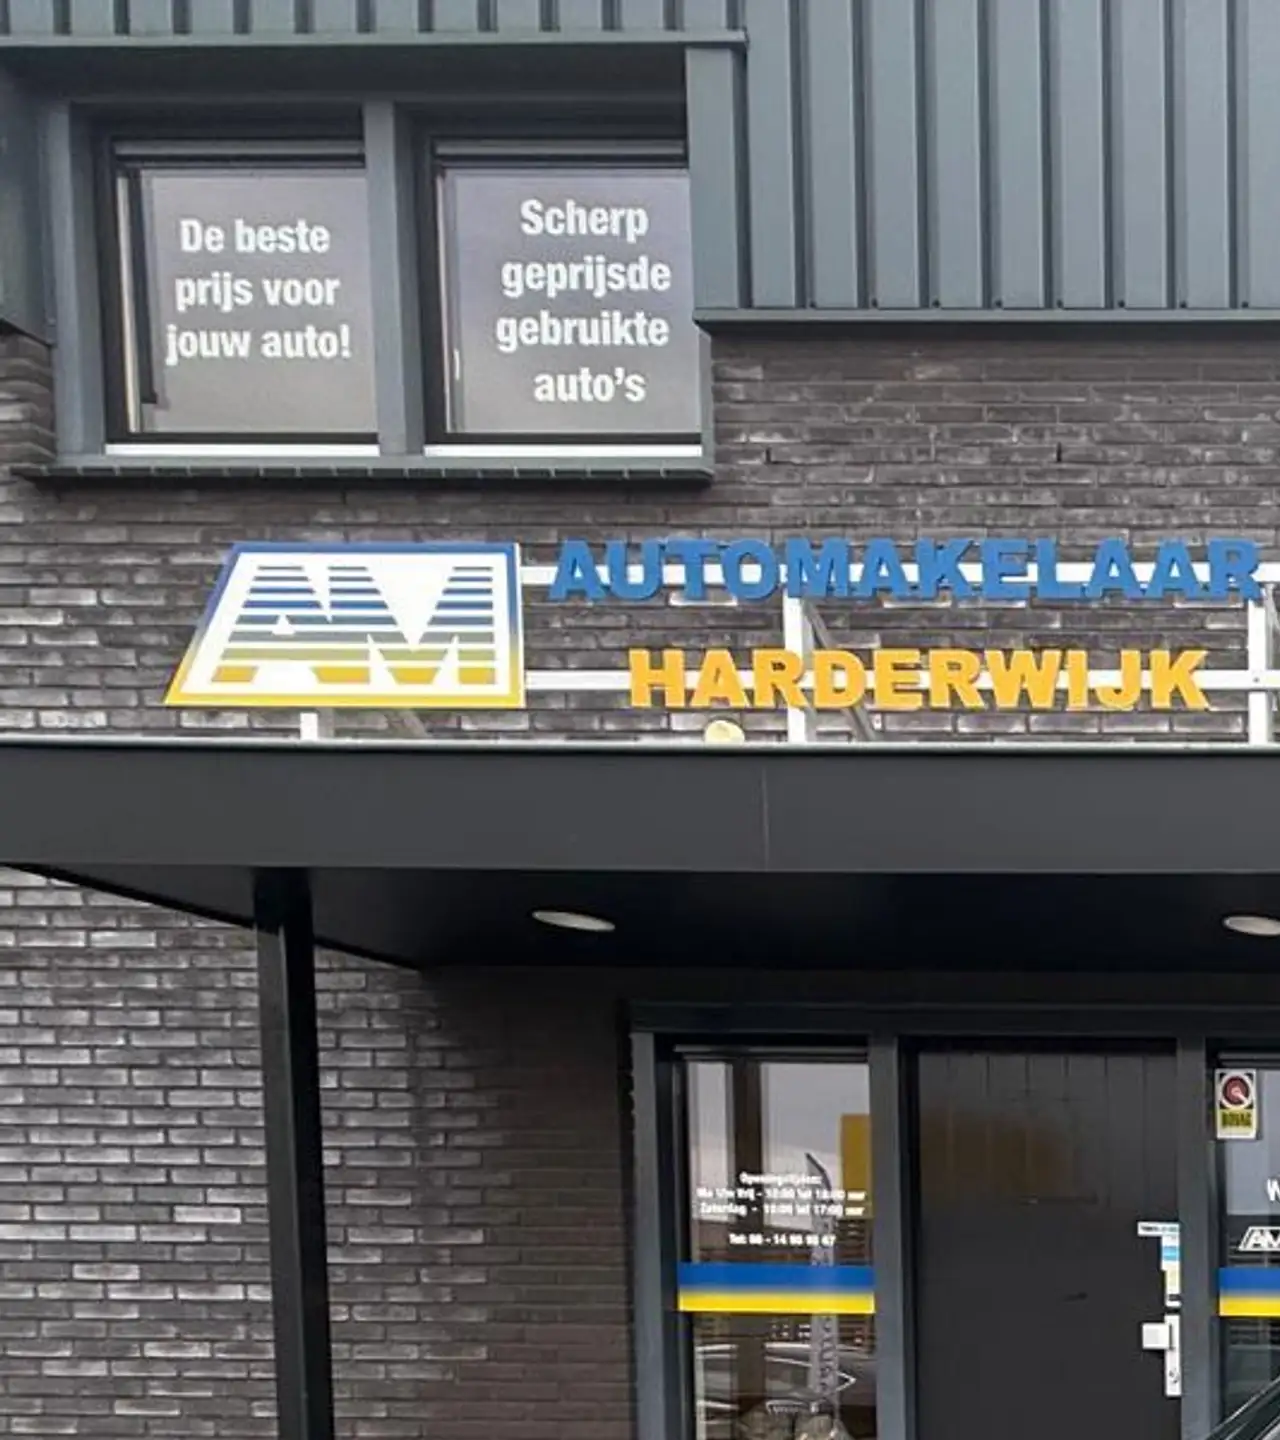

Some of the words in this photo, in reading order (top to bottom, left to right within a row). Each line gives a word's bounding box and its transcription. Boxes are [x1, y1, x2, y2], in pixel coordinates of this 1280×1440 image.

[180, 218, 225, 253] De
[235, 218, 331, 253] beste
[520, 198, 650, 244] Scherp
[175, 270, 253, 313] prijs
[262, 278, 341, 307] voor
[501, 255, 672, 299] geprijsde
[165, 323, 251, 367] jouw
[261, 323, 352, 359] auto!
[495, 310, 670, 354] gebruikte
[533, 367, 647, 403] auto's
[548, 537, 1264, 602] AUTOMAKELAAR
[210, 564, 497, 685] AM
[629, 647, 1210, 710] HARDERWIJK
